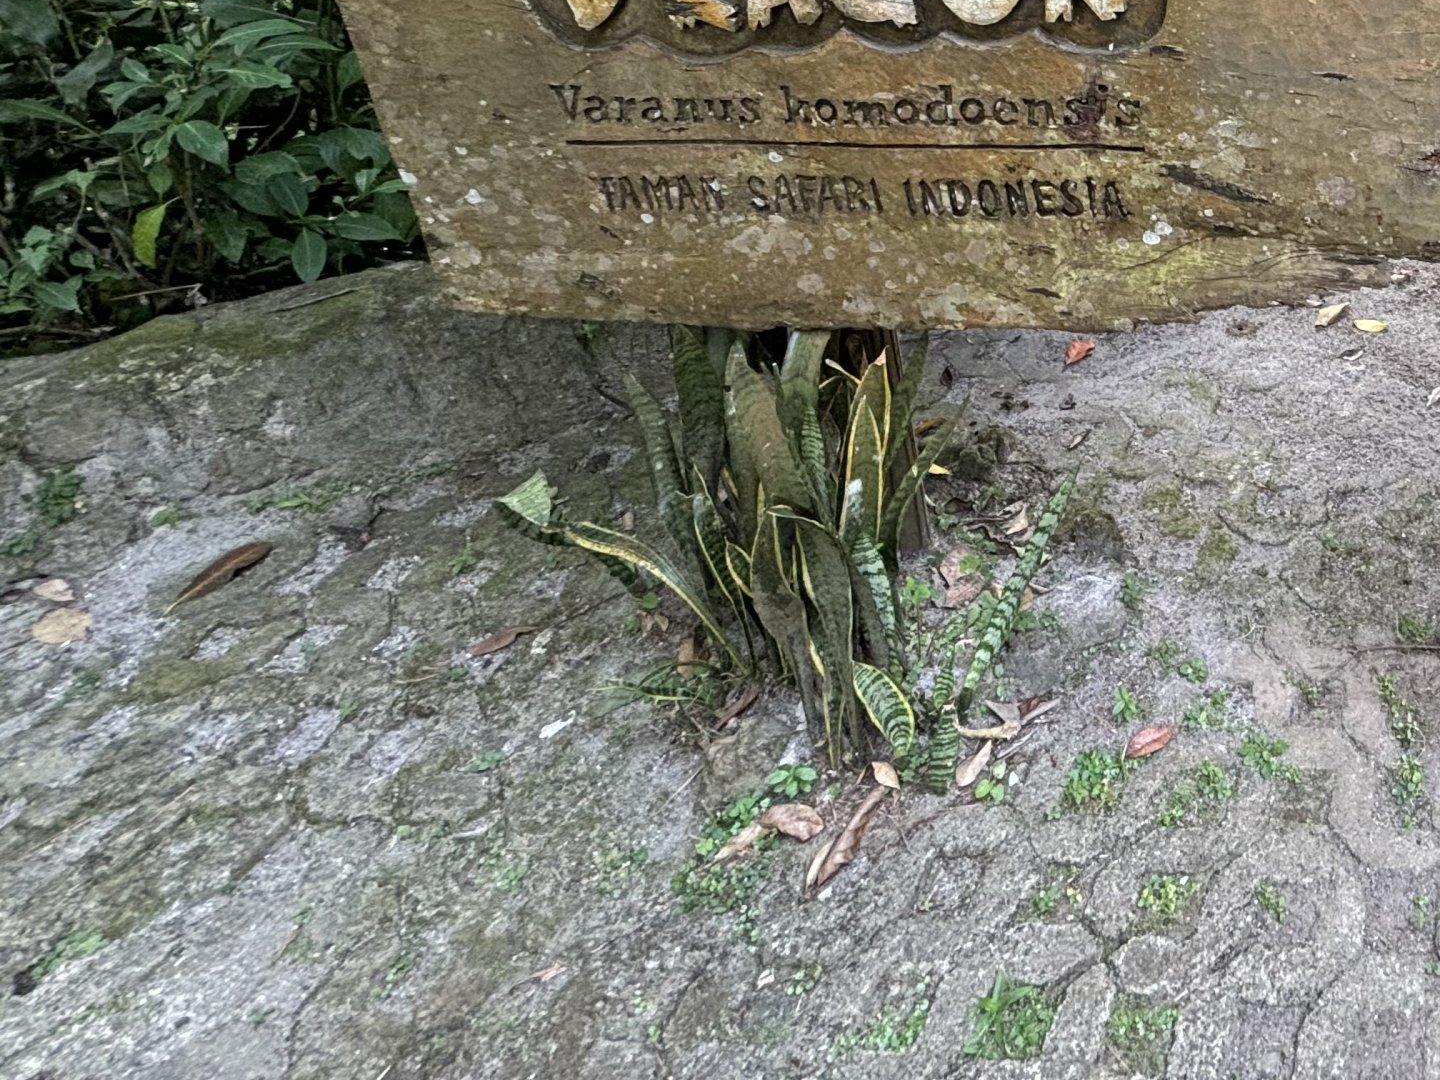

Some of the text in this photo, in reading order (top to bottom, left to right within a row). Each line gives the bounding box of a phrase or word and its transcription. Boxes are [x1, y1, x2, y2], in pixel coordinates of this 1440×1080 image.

[549, 83, 1141, 127] Varanus komodoensis
[600, 174, 1133, 217] TAMAN SAFARI INDONESIA
